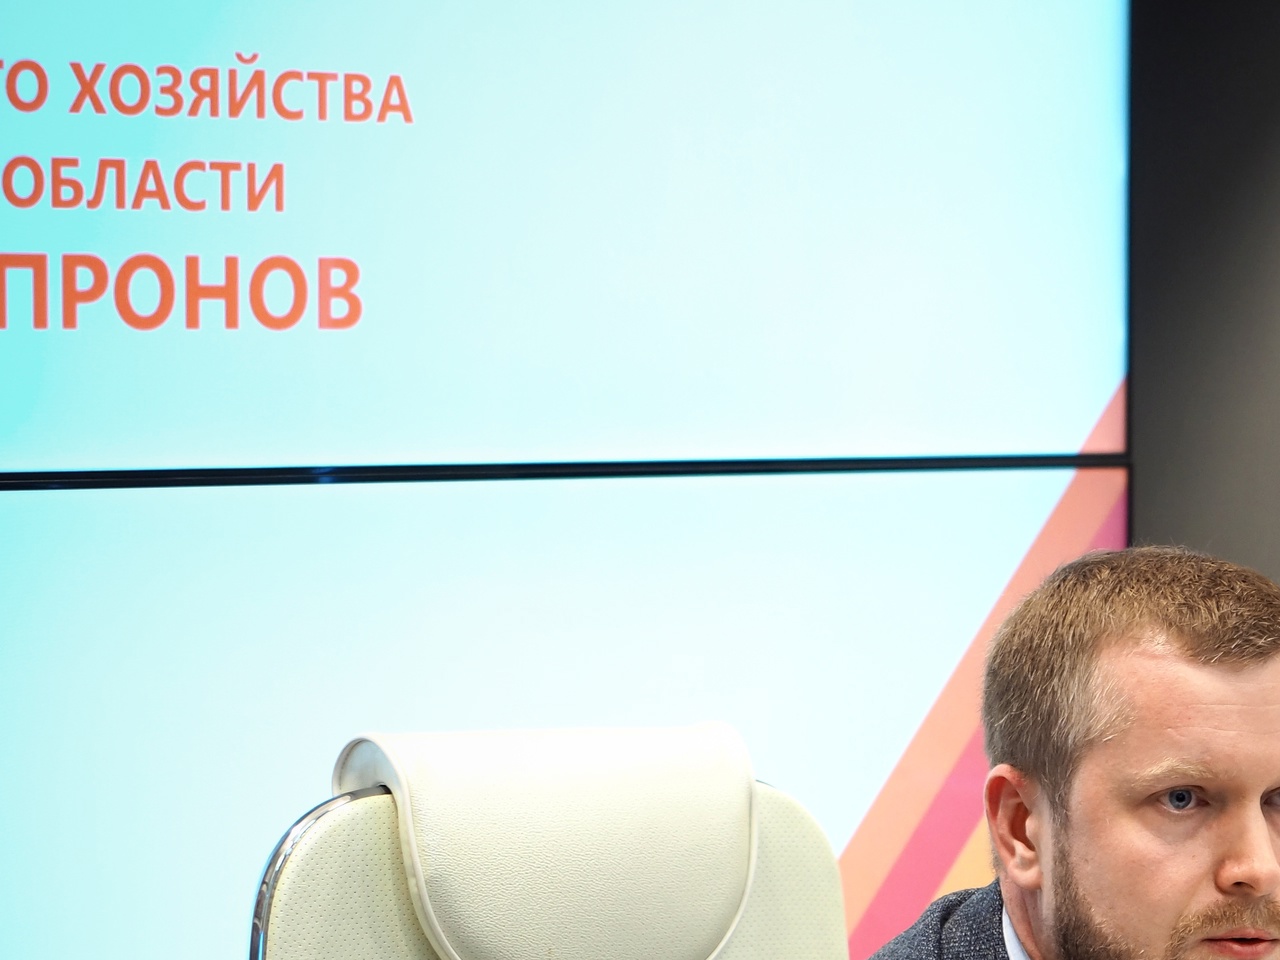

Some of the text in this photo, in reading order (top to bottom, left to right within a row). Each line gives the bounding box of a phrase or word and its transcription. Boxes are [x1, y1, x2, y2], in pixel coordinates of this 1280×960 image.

[0, 51, 414, 124] О ХОЗЯЙСТВА
[2, 155, 285, 212] ОБЛАСТИ
